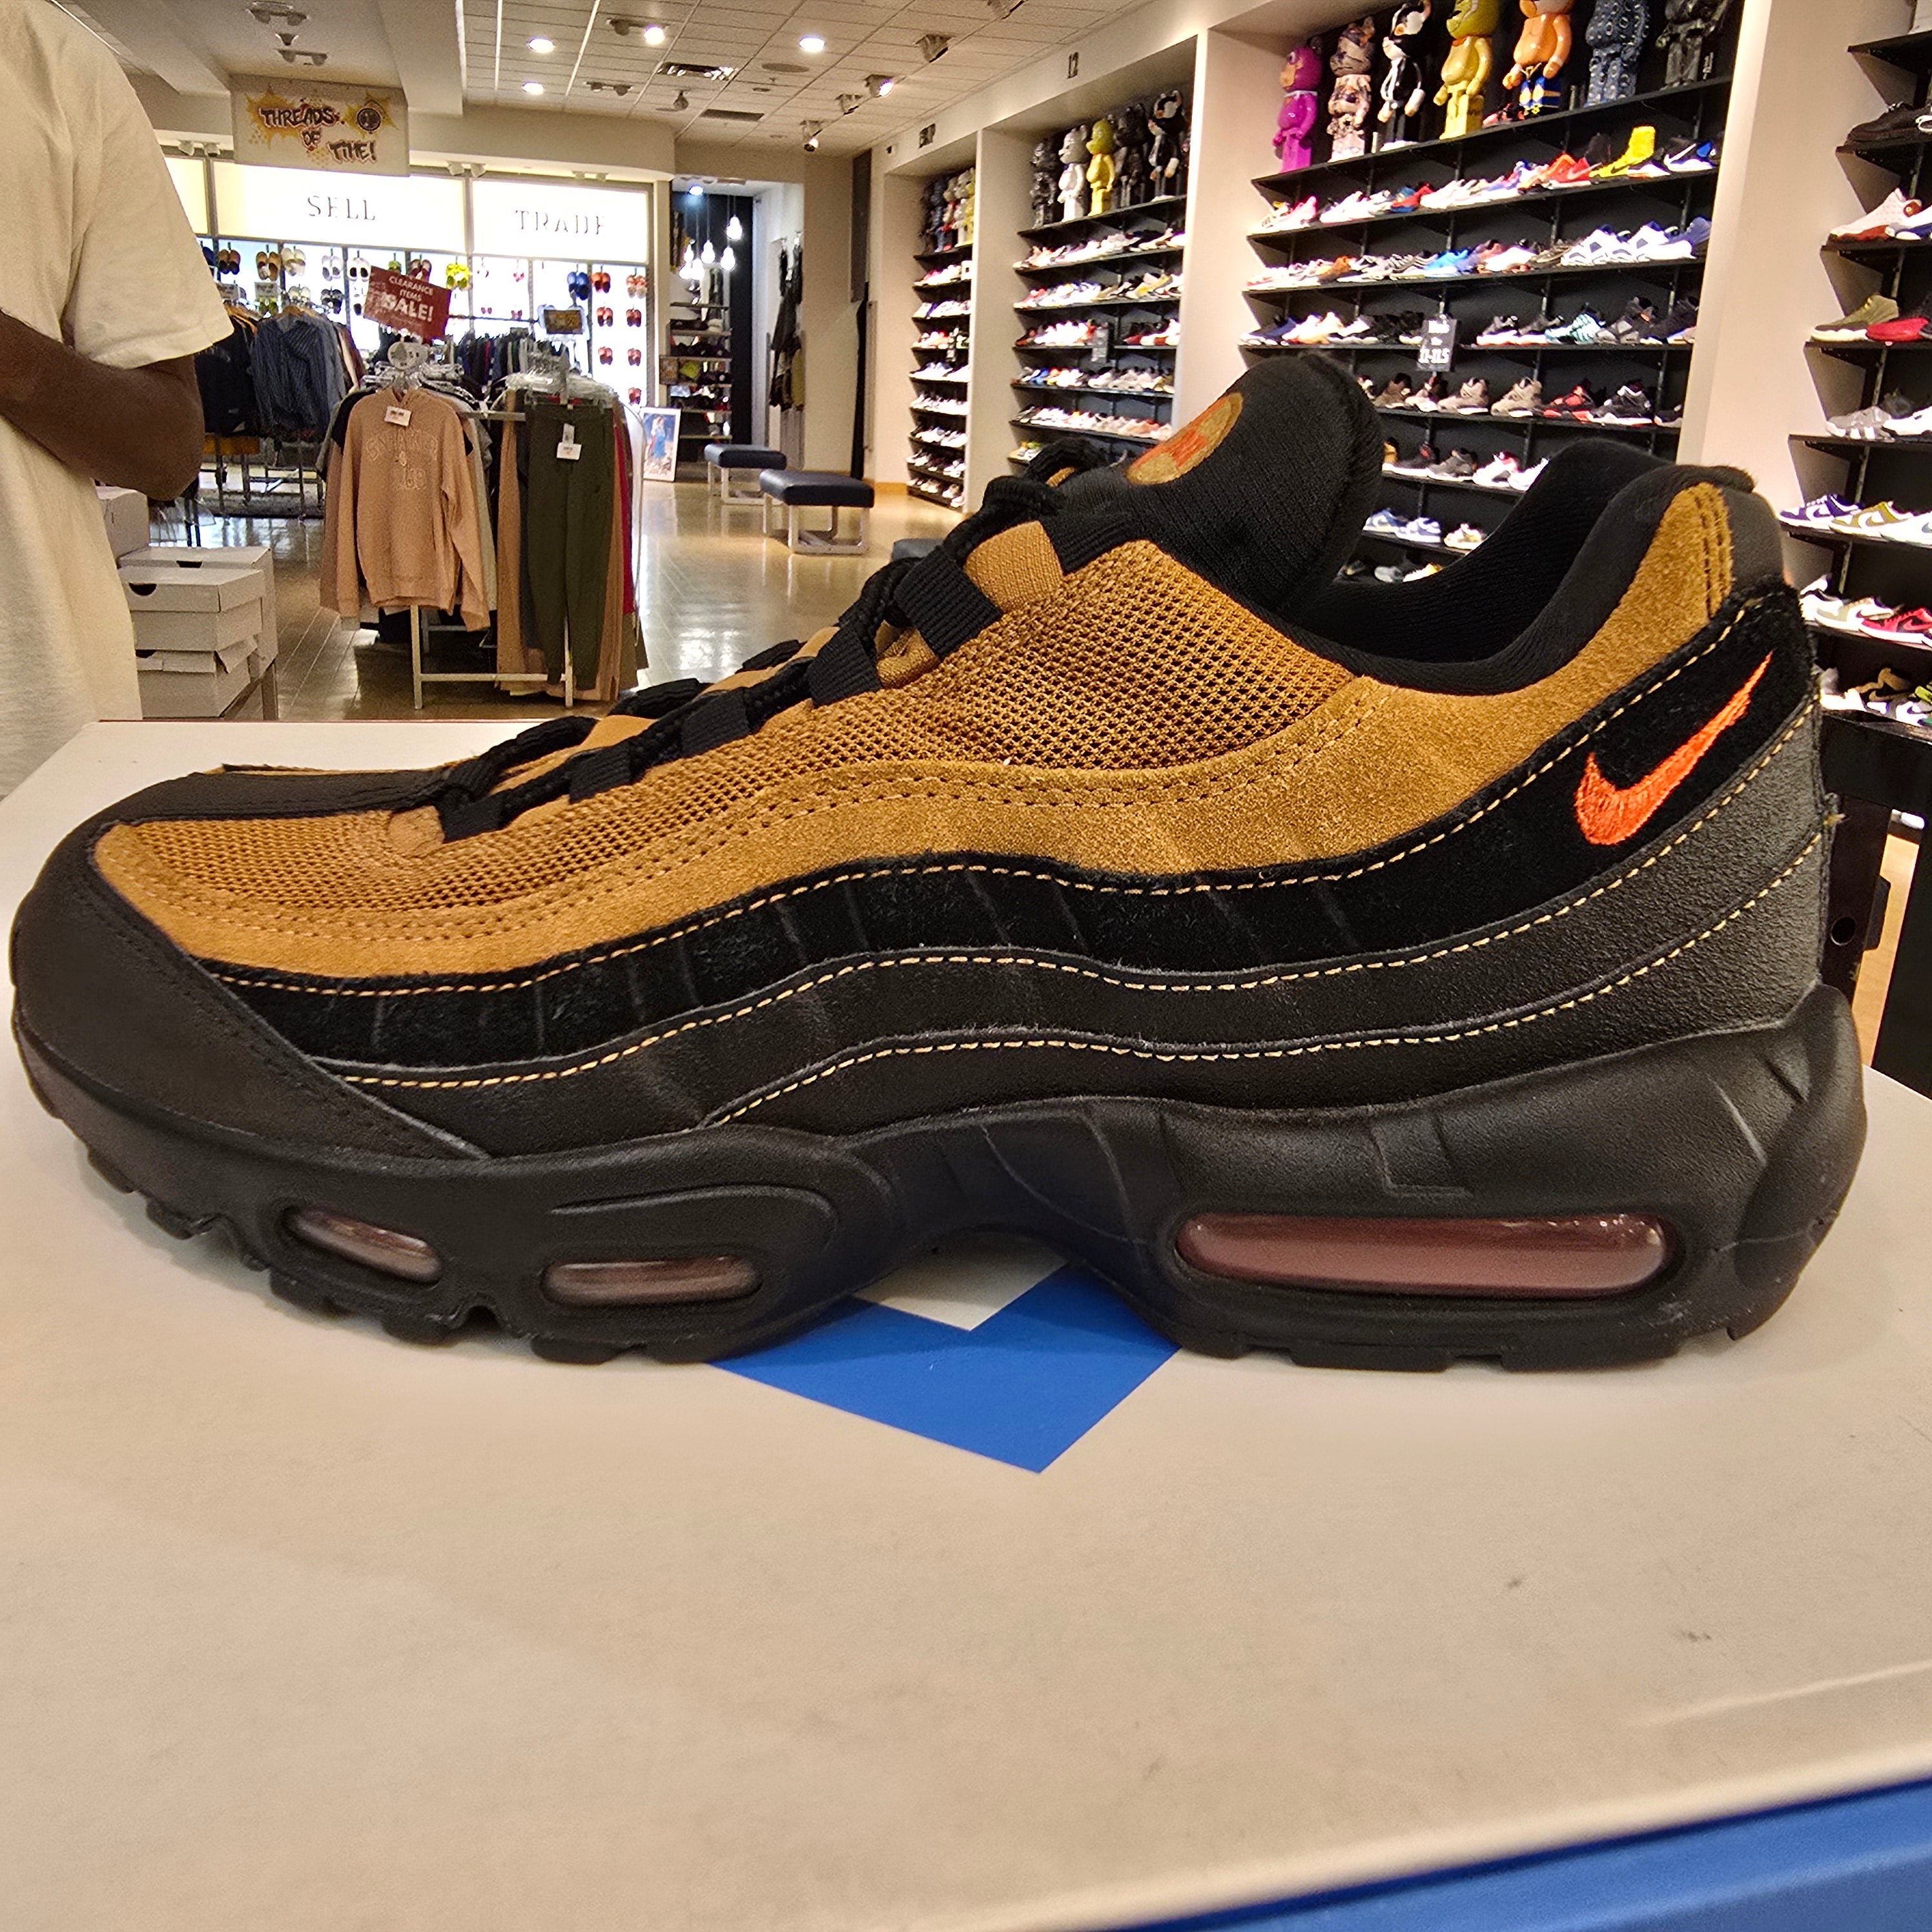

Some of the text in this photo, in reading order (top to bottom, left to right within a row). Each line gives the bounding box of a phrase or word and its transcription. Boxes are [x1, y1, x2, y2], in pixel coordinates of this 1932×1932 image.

[260, 107, 336, 127] THREADS
[302, 130, 322, 147] OF
[307, 195, 375, 220] SELL
[515, 210, 605, 235] TRADE
[389, 276, 434, 295] CLEARANCE
[399, 290, 422, 302] ITEMS
[382, 294, 433, 322] SALE!
